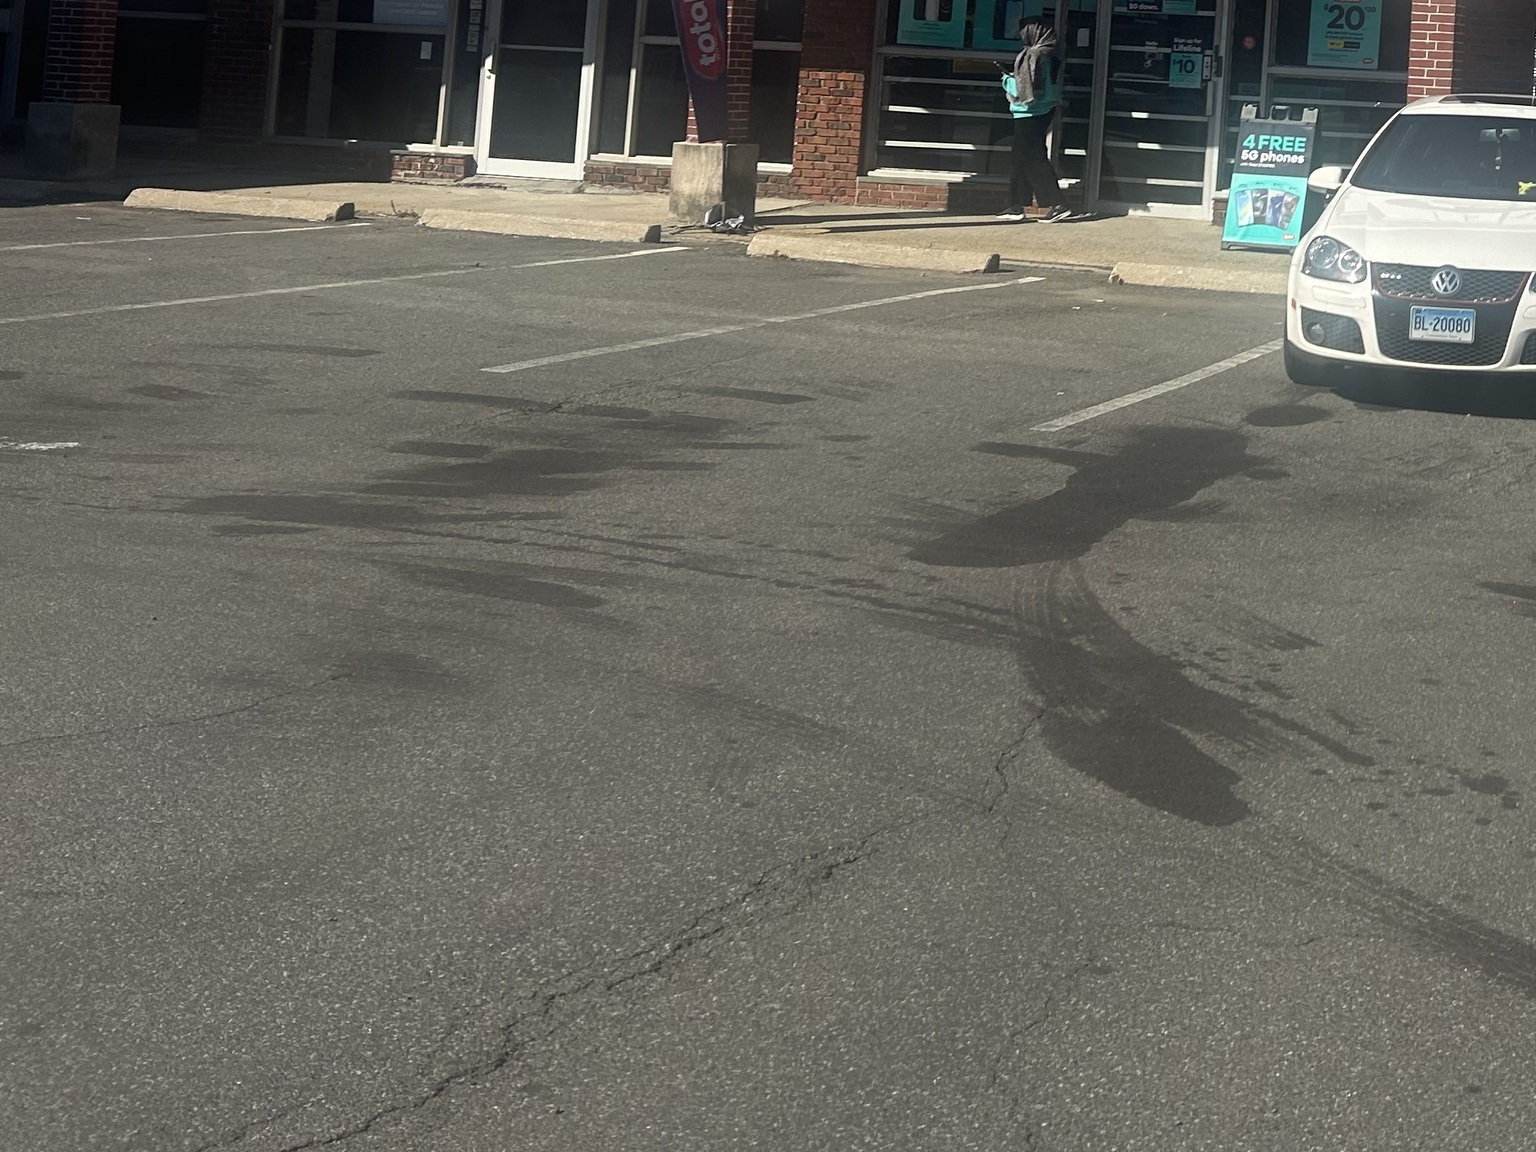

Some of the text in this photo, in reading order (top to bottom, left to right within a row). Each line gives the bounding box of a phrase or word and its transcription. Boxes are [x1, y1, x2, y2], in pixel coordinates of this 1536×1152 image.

[1243, 134, 1307, 152] 4 FREE
[1241, 149, 1305, 164] 5G phones
